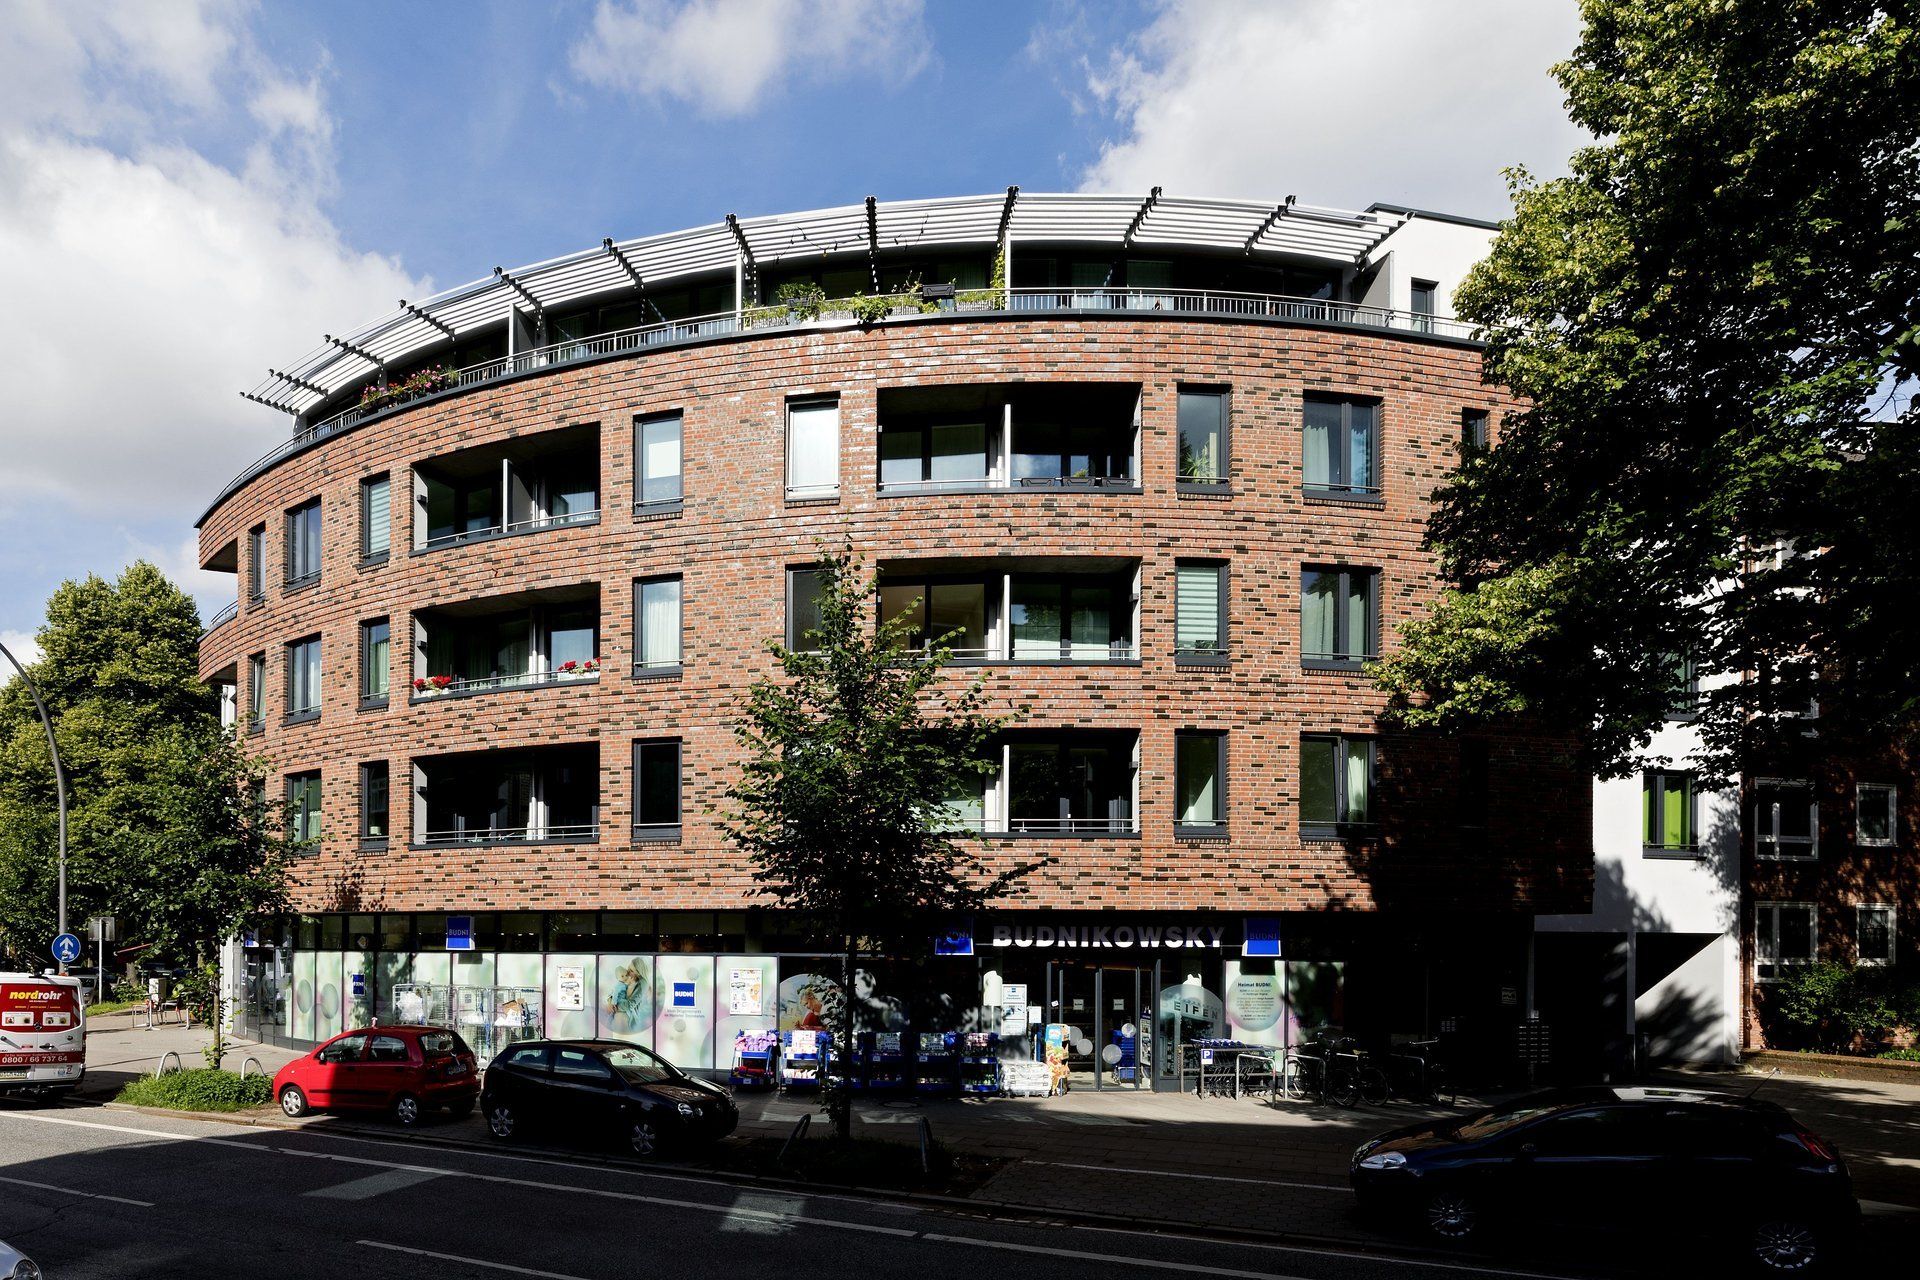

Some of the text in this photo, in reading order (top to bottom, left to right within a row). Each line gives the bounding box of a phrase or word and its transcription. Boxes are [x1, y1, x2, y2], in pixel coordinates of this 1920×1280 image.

[448, 928, 469, 936] BUDNI
[992, 925, 1225, 948] BUDNIKOWSKY
[1249, 931, 1277, 940] BUDNI
[9, 990, 62, 1000] nordrohr
[1203, 1050, 1210, 1059] P
